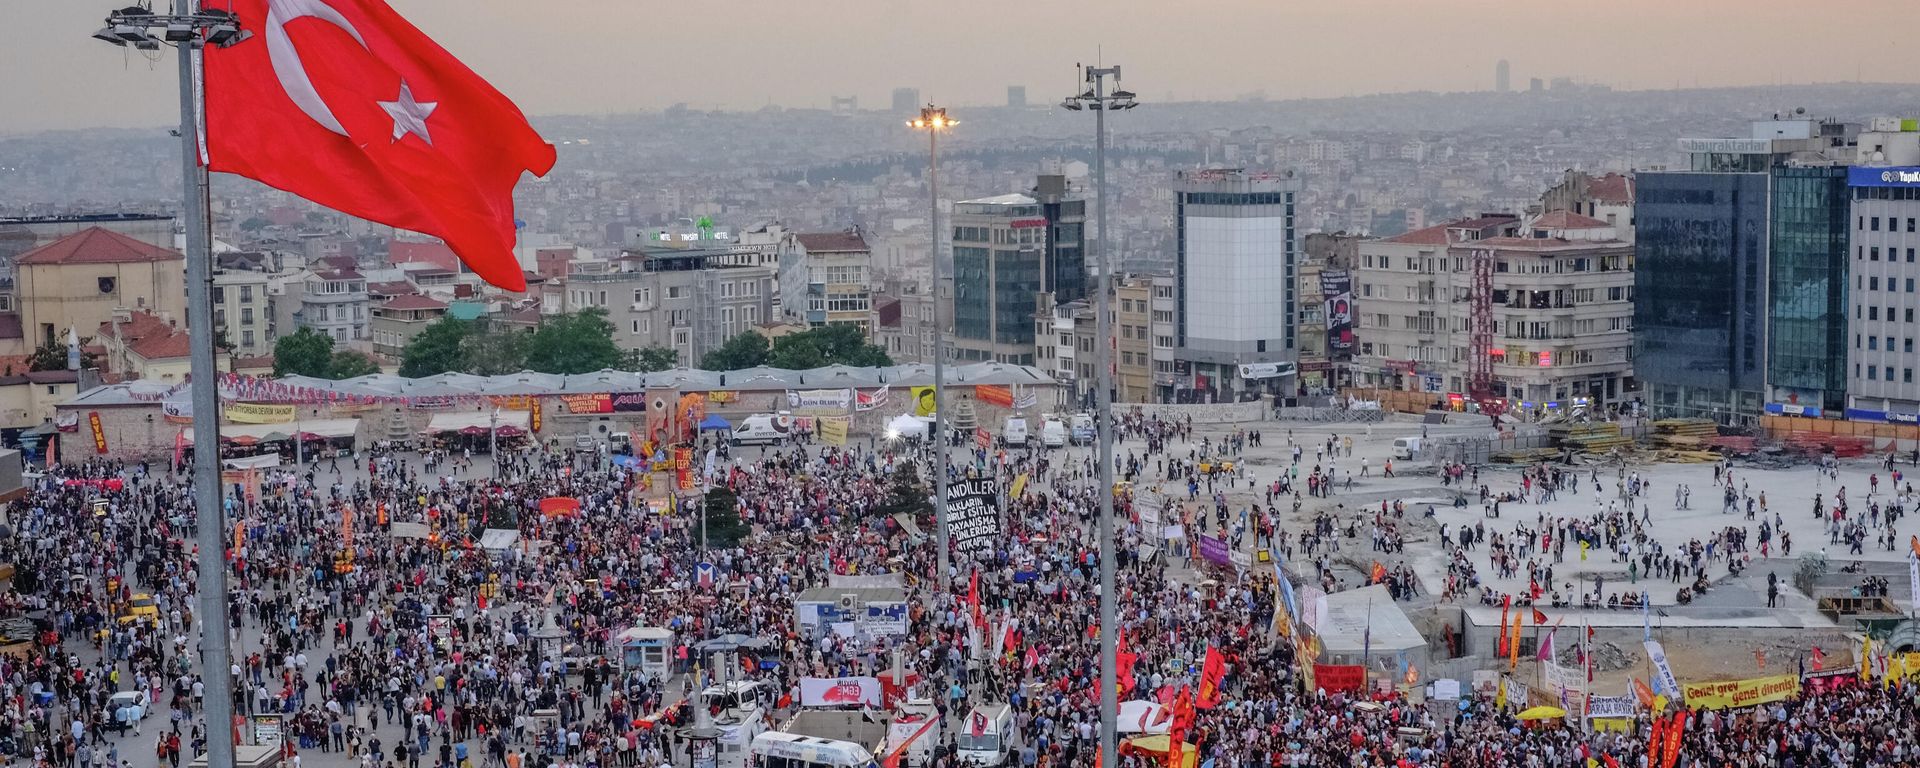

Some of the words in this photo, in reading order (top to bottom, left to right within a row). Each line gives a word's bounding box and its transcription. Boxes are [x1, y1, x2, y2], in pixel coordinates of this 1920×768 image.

[1900, 171, 1920, 183] YapıK
[532, 398, 541, 430] SYKP
[91, 416, 104, 448] SYKP
[948, 480, 994, 500] ANDİLLER
[1687, 684, 1714, 699] Genel
[1718, 682, 1738, 697] grev
[1732, 686, 1758, 705] genel
